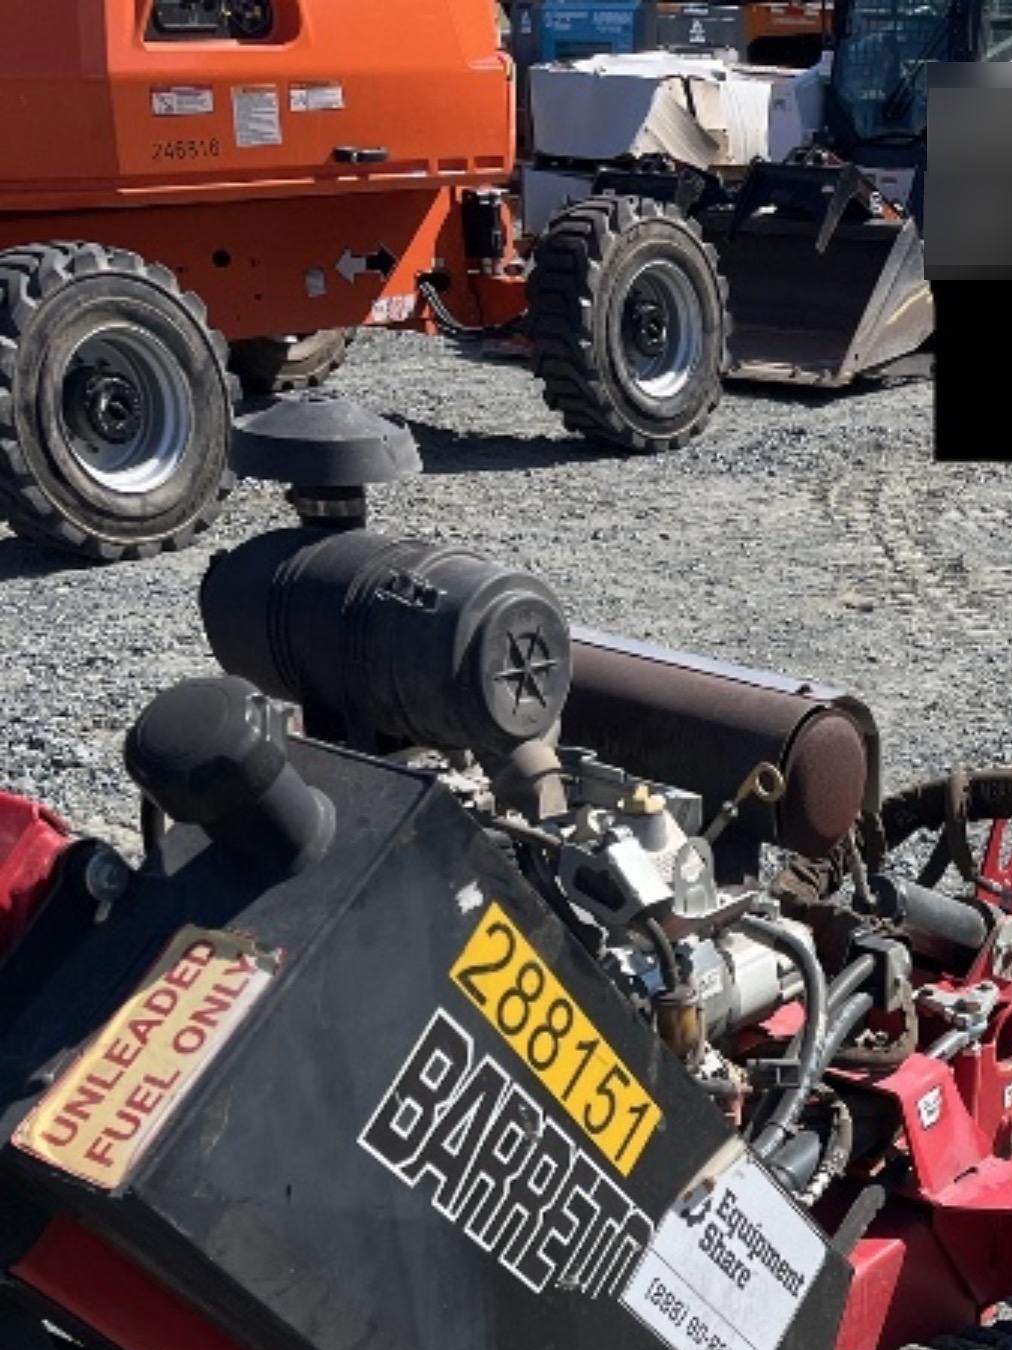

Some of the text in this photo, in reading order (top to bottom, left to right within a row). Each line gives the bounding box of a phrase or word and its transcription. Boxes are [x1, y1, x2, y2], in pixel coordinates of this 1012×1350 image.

[41, 938, 216, 1147] UNLEADED
[84, 951, 257, 1167] FUEL ONLY
[457, 923, 650, 1162] 288151
[644, 1277, 688, 1328] (888)
[698, 1222, 752, 1291] Share
[716, 1187, 805, 1299] Equipment
